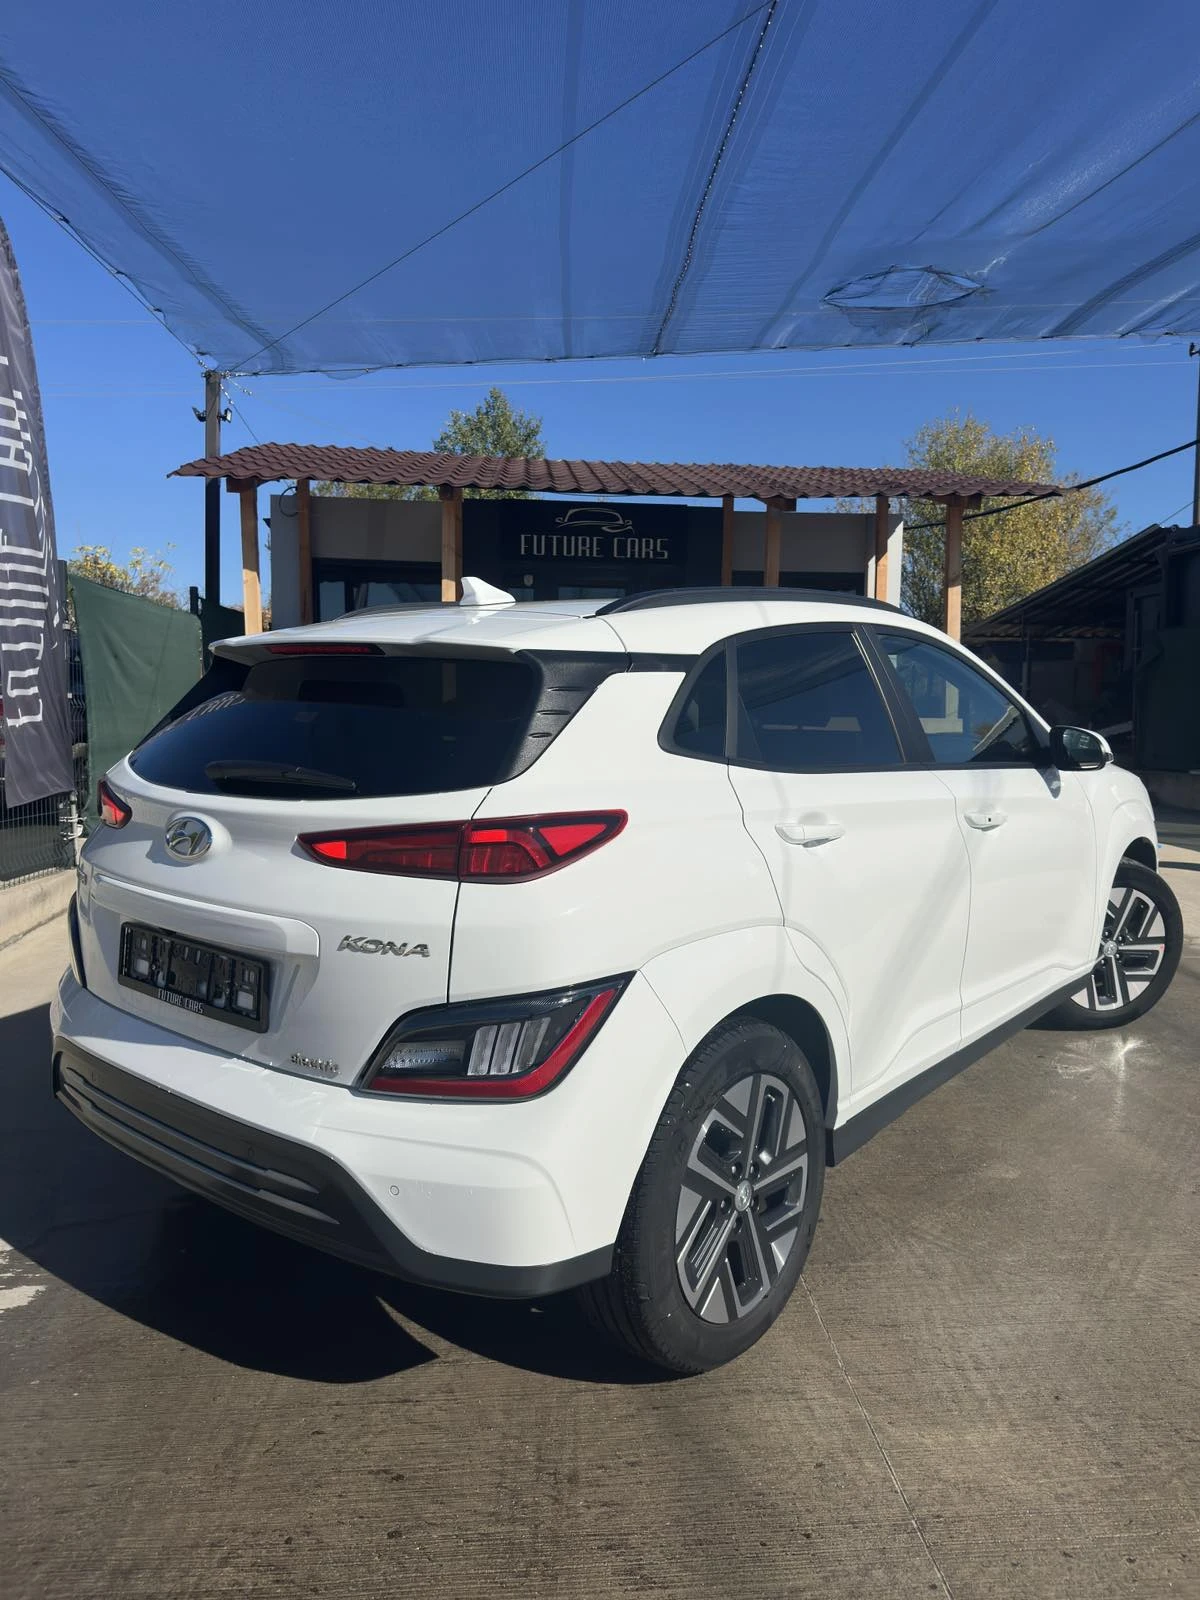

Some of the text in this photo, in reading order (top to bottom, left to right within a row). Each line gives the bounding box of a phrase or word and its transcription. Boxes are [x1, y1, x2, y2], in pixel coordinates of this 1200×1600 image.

[519, 534, 670, 560] FUTURE CARS
[336, 934, 431, 958] KONA
[157, 988, 204, 1014] FUTURE CARS
